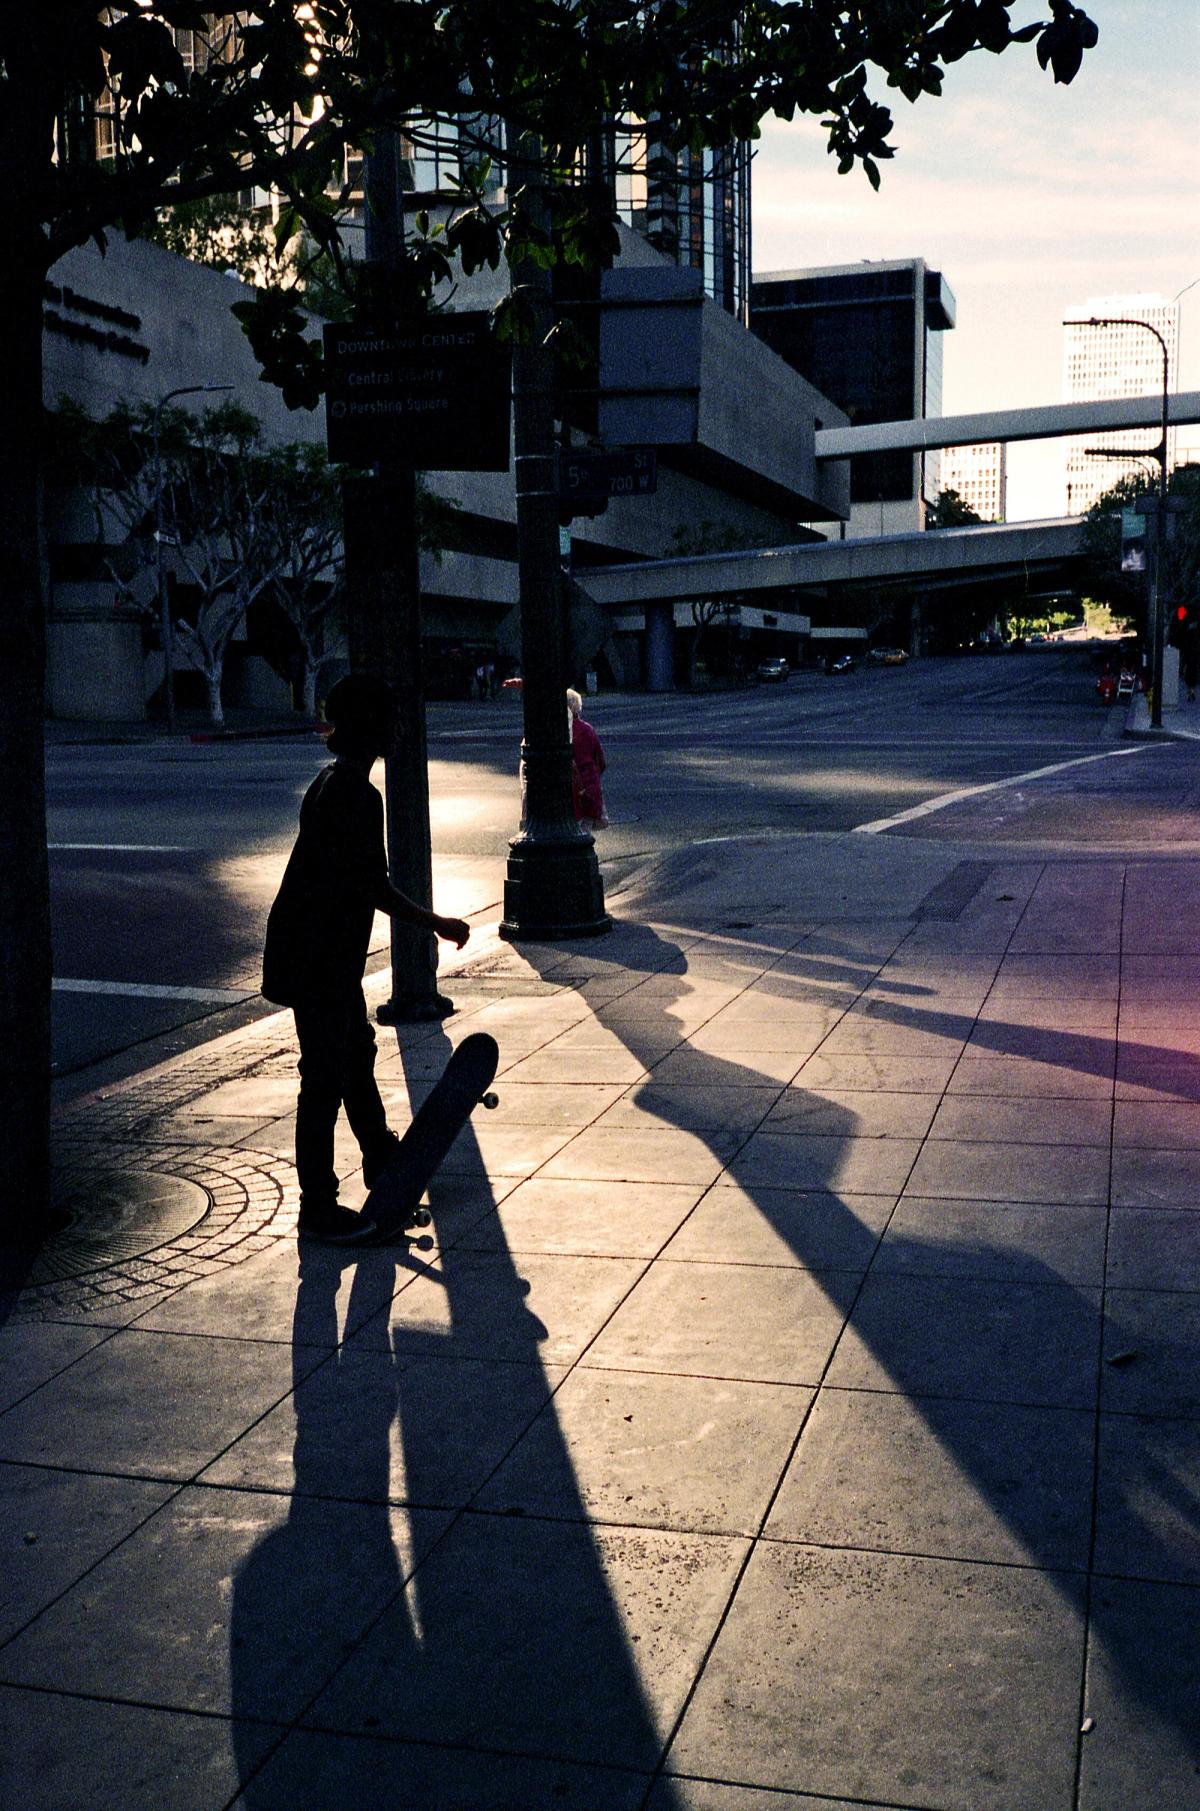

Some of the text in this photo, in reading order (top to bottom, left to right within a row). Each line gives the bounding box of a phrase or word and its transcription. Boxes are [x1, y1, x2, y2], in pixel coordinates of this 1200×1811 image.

[348, 369, 393, 386] Central
[407, 398, 449, 413] Square
[609, 473, 634, 492] 700
